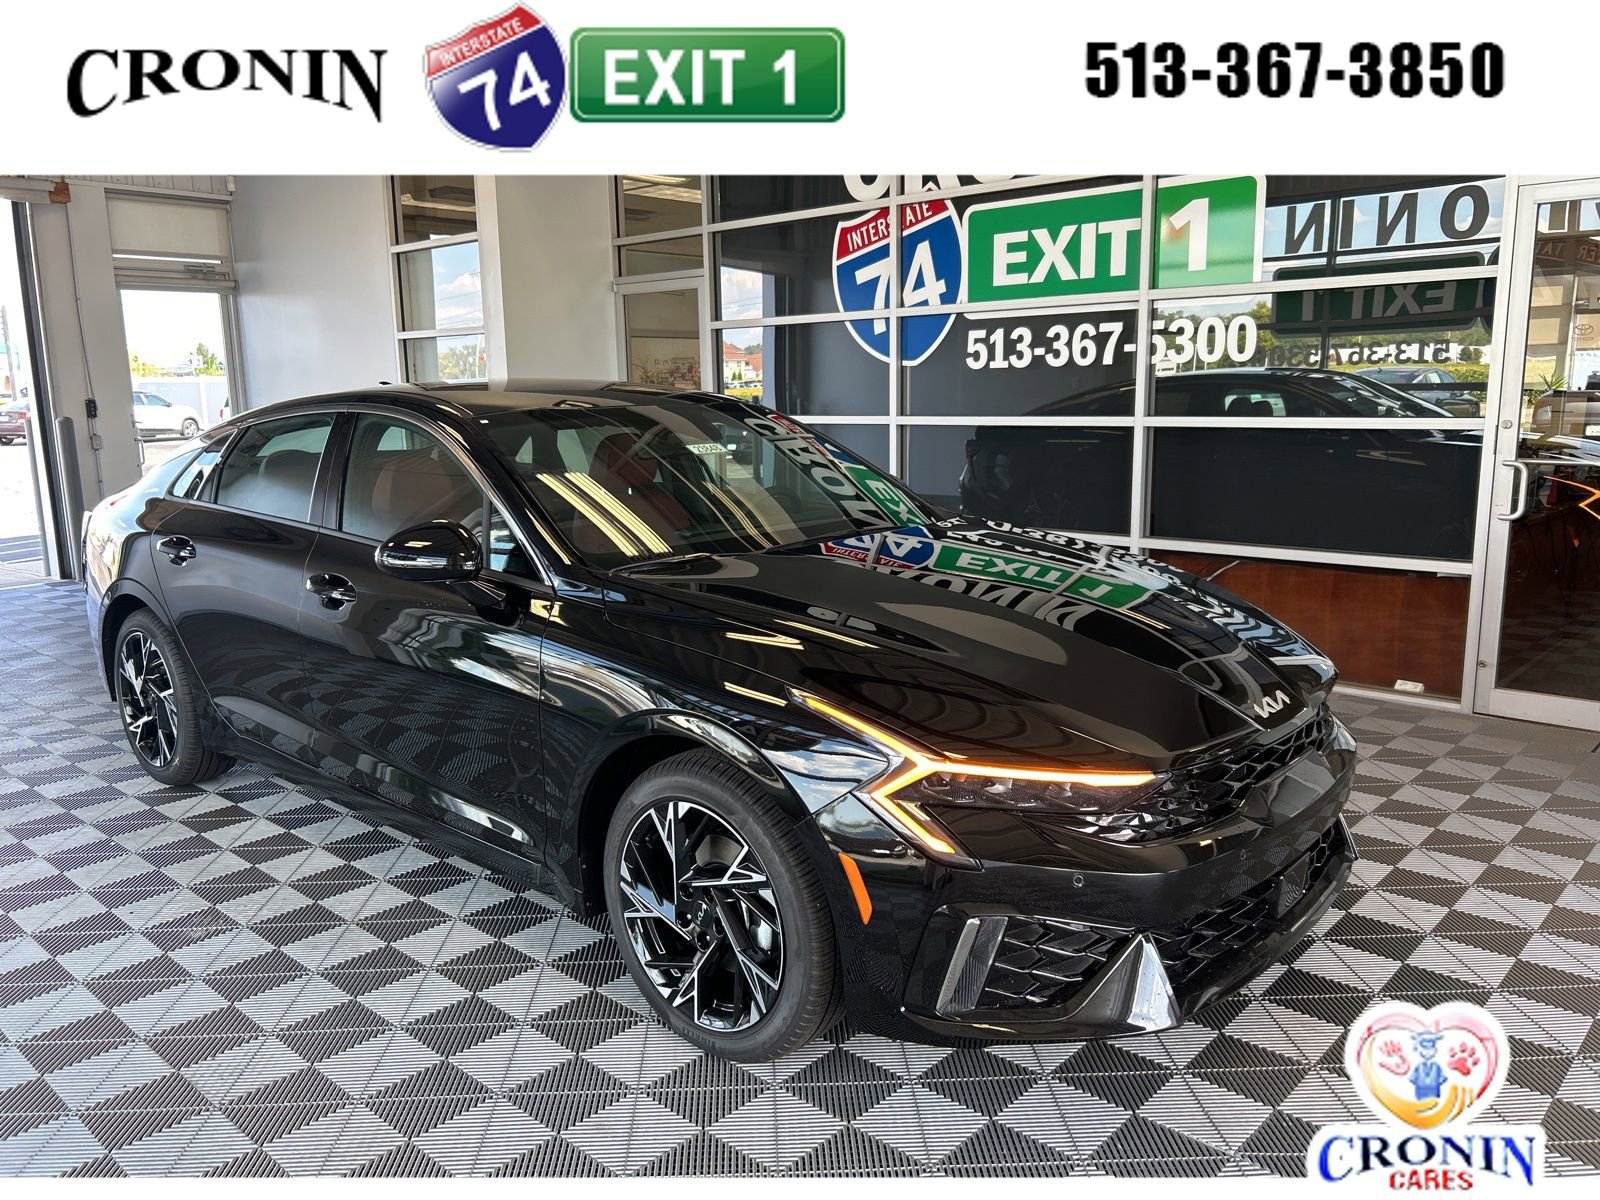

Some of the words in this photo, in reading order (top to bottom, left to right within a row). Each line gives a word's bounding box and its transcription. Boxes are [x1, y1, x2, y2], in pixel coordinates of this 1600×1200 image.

[847, 203, 933, 252] INTERATE
[992, 218, 1142, 287] EXIT
[1168, 197, 1209, 272] 1
[854, 239, 947, 336] 74
[965, 314, 1258, 370] 513-367-5300
[1253, 689, 1291, 718] KIA
